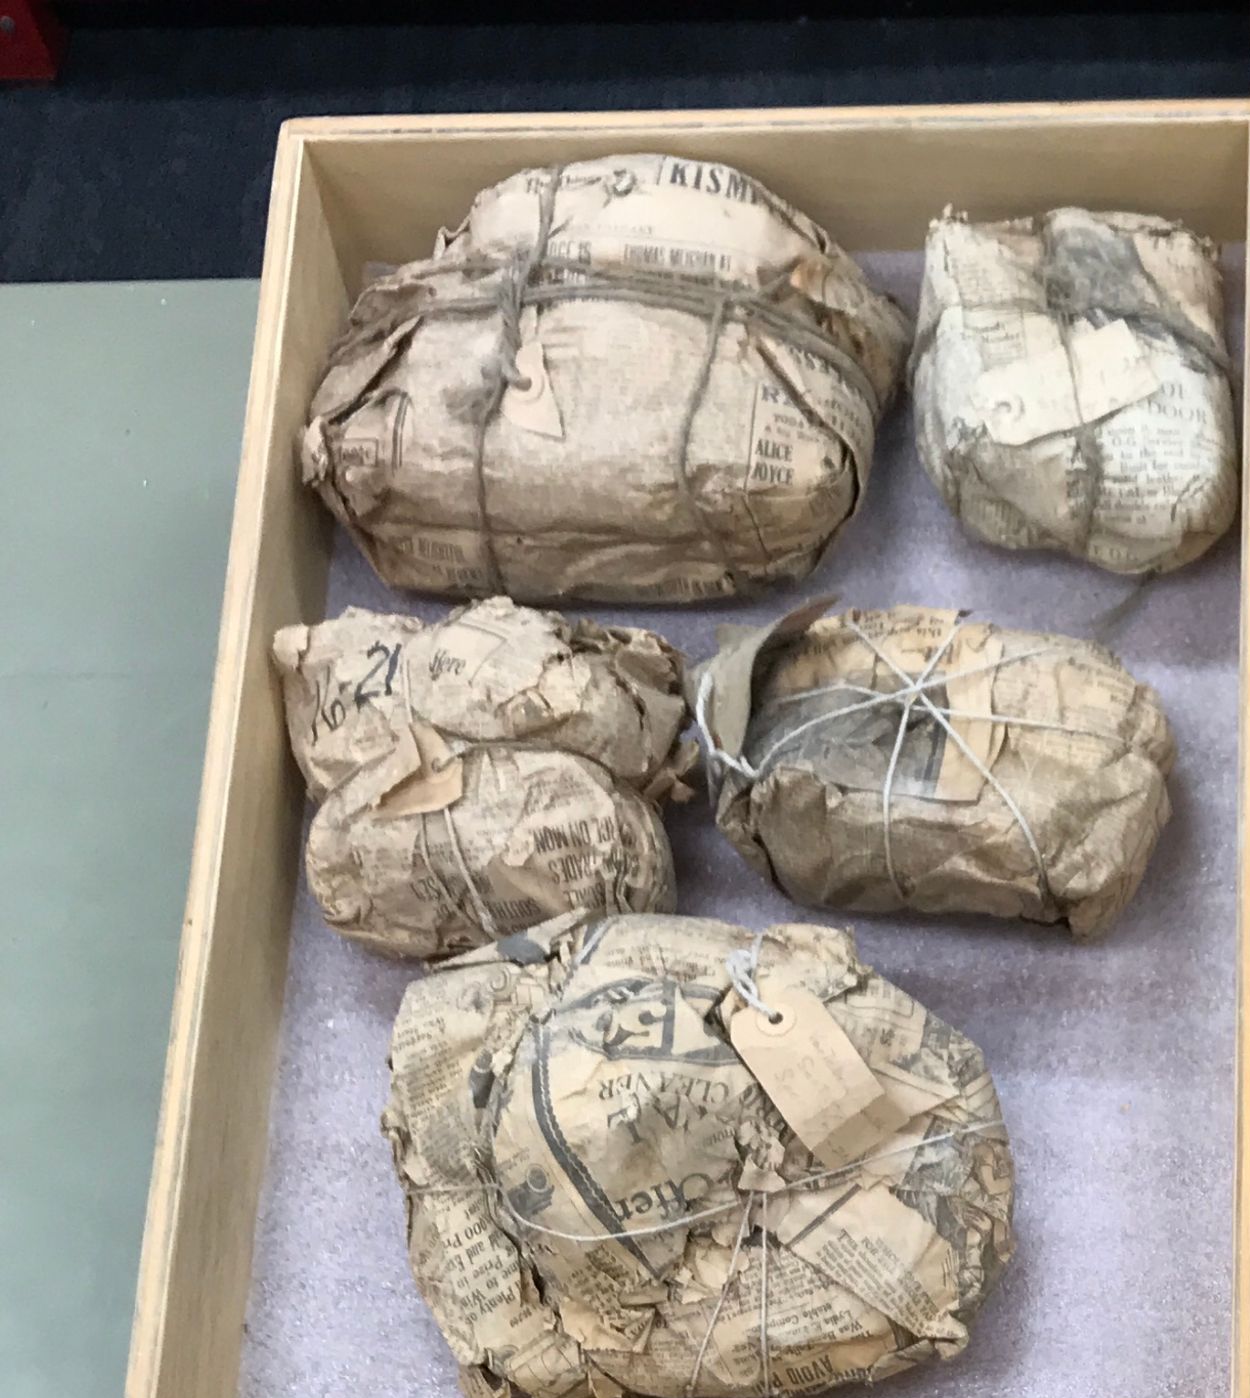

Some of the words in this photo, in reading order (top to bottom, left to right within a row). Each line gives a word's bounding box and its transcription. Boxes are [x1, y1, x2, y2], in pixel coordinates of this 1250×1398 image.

[755, 438, 793, 463] ALICE
[751, 461, 794, 486] JOYCE
[596, 1070, 730, 1102] CLEAVER
[479, 1286, 516, 1316] Plenty
[786, 1355, 834, 1386] AVOID
